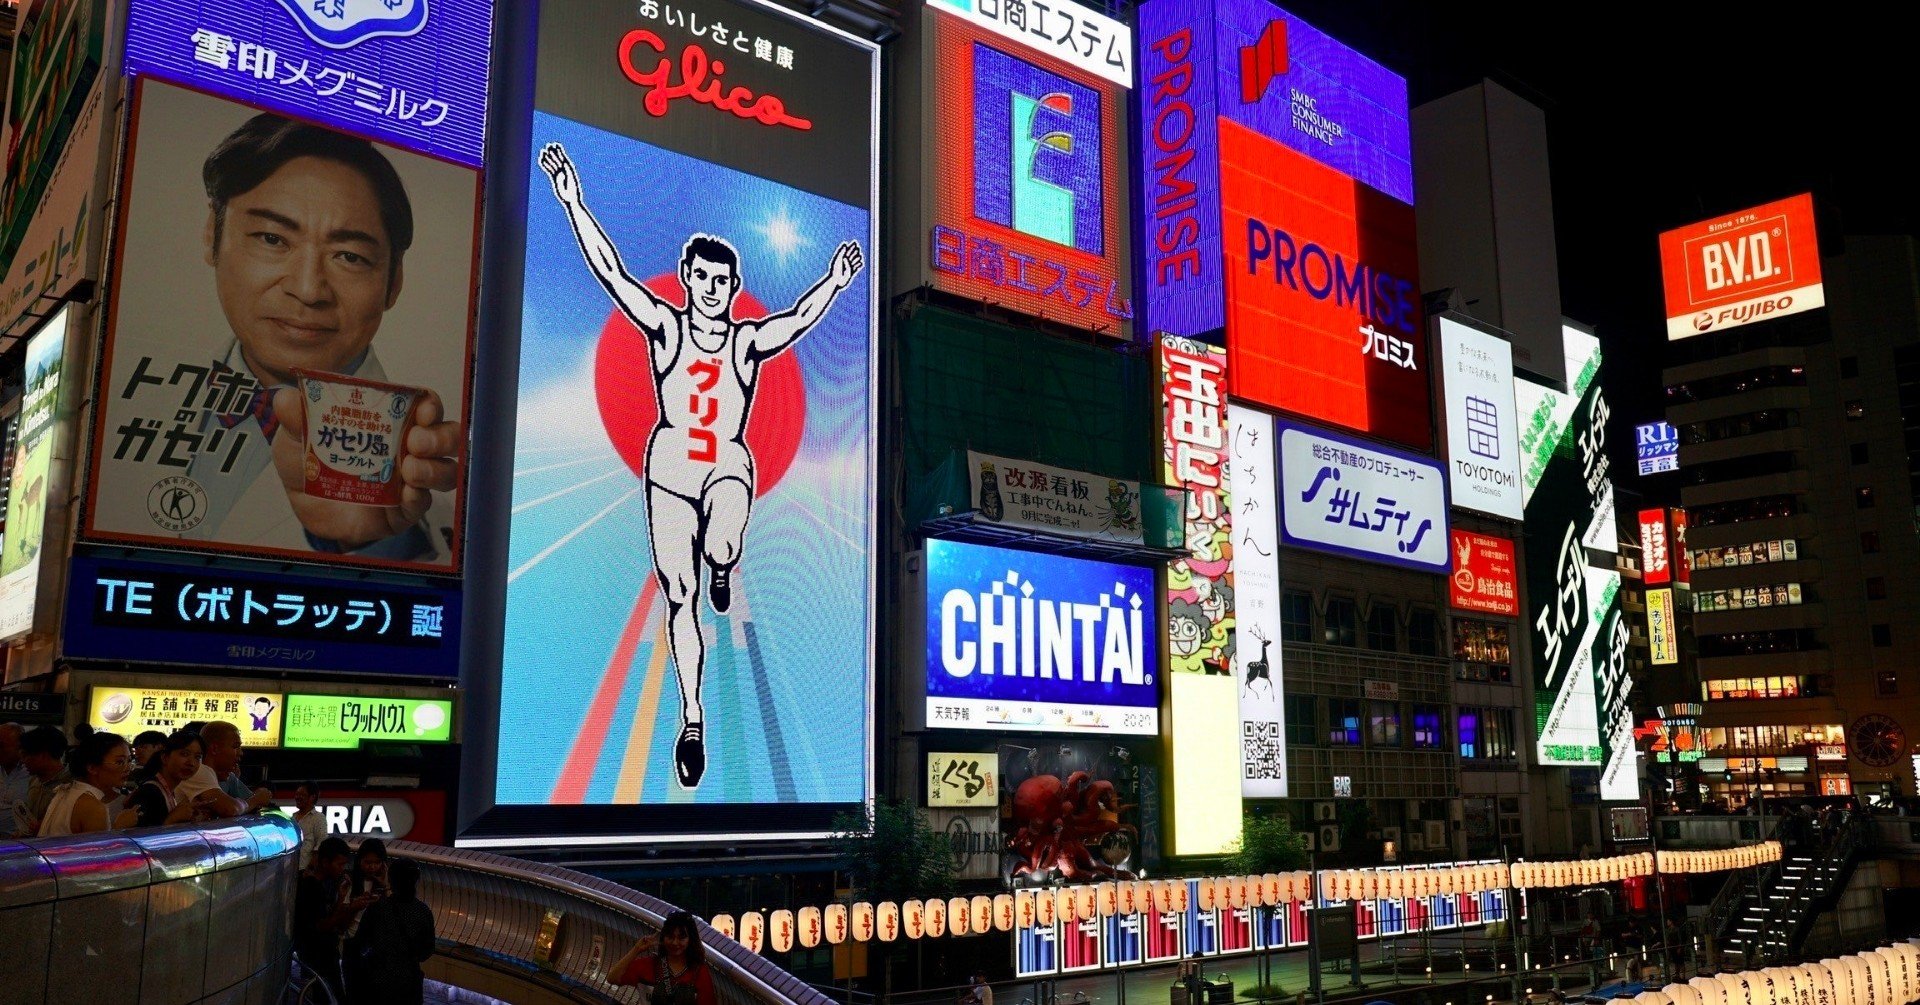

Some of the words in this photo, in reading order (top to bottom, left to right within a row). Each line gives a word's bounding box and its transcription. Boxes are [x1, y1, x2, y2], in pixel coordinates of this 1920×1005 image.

[639, 0, 794, 71] おいしさと健康
[191, 27, 448, 127] 雪印メグミルク
[617, 28, 812, 131] Glico
[1290, 87, 1317, 113] SMBC
[1290, 103, 1343, 139] CONSUMER
[1292, 118, 1333, 147] FINANCE
[1151, 27, 1201, 286] PROMISE
[1708, 219, 1732, 233] Since
[931, 223, 1134, 320] 日商エステム
[1247, 217, 1415, 333] PROMISE
[1702, 230, 1782, 291] B.V.D.
[1717, 295, 1793, 324] FUJIBO
[1358, 324, 1418, 371] プロミス
[121, 356, 258, 416] トクホ
[347, 387, 365, 406] 恵
[173, 408, 198, 424] の
[686, 357, 723, 464] グリコ
[112, 416, 248, 474] ガセリ
[329, 453, 375, 470] ヨーグルト
[1311, 442, 1425, 483] 総合不動産のプロデューサー
[1003, 466, 1090, 501] 改源看板
[1472, 484, 1502, 499] HOLDINGS
[1007, 491, 1094, 518] 工事中でんねん。
[1652, 520, 1668, 572] カラオケ
[941, 569, 1144, 686] CHINTAI
[1650, 609, 1665, 661] ネットルーム
[227, 644, 317, 661] 雪印メグミルク
[0, 695, 39, 711] ilets
[141, 697, 239, 713] 店舗情報館
[340, 702, 406, 733] ピタットハウス
[934, 706, 970, 721] 天気予報
[941, 759, 986, 799] くくる
